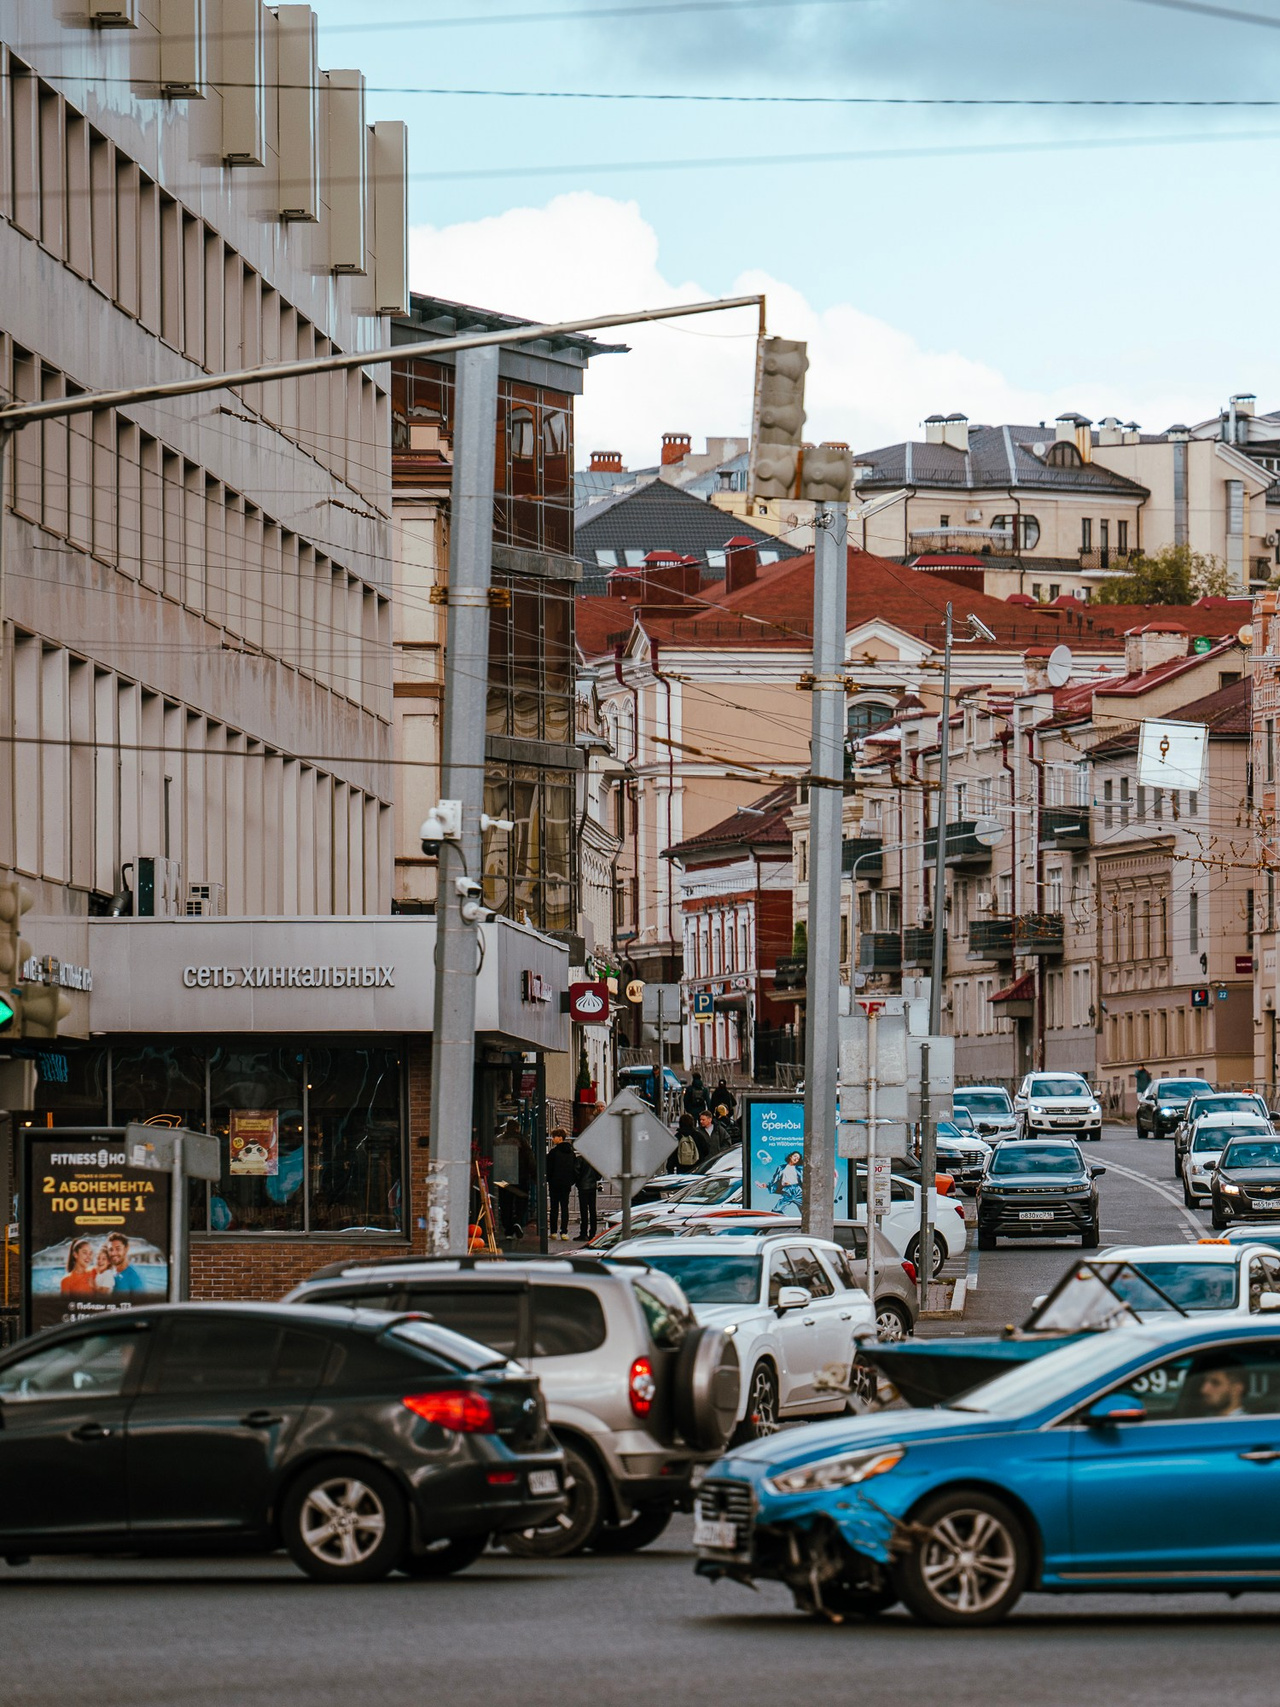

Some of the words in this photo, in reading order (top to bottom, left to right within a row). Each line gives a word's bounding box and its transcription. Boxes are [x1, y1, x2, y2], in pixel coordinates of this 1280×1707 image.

[183, 965, 236, 988] сеть
[240, 965, 396, 988] хинкальных
[699, 995, 709, 1011] P
[761, 1110, 778, 1120] wb
[761, 1119, 801, 1131] бренды
[51, 1153, 97, 1165] FITNESS
[109, 1153, 126, 1165] HO
[43, 1176, 56, 1193] 2
[59, 1181, 155, 1193] АБОНЕМЕНТА
[52, 1197, 79, 1212] ПО
[83, 1197, 131, 1214] ЦЕНЕ
